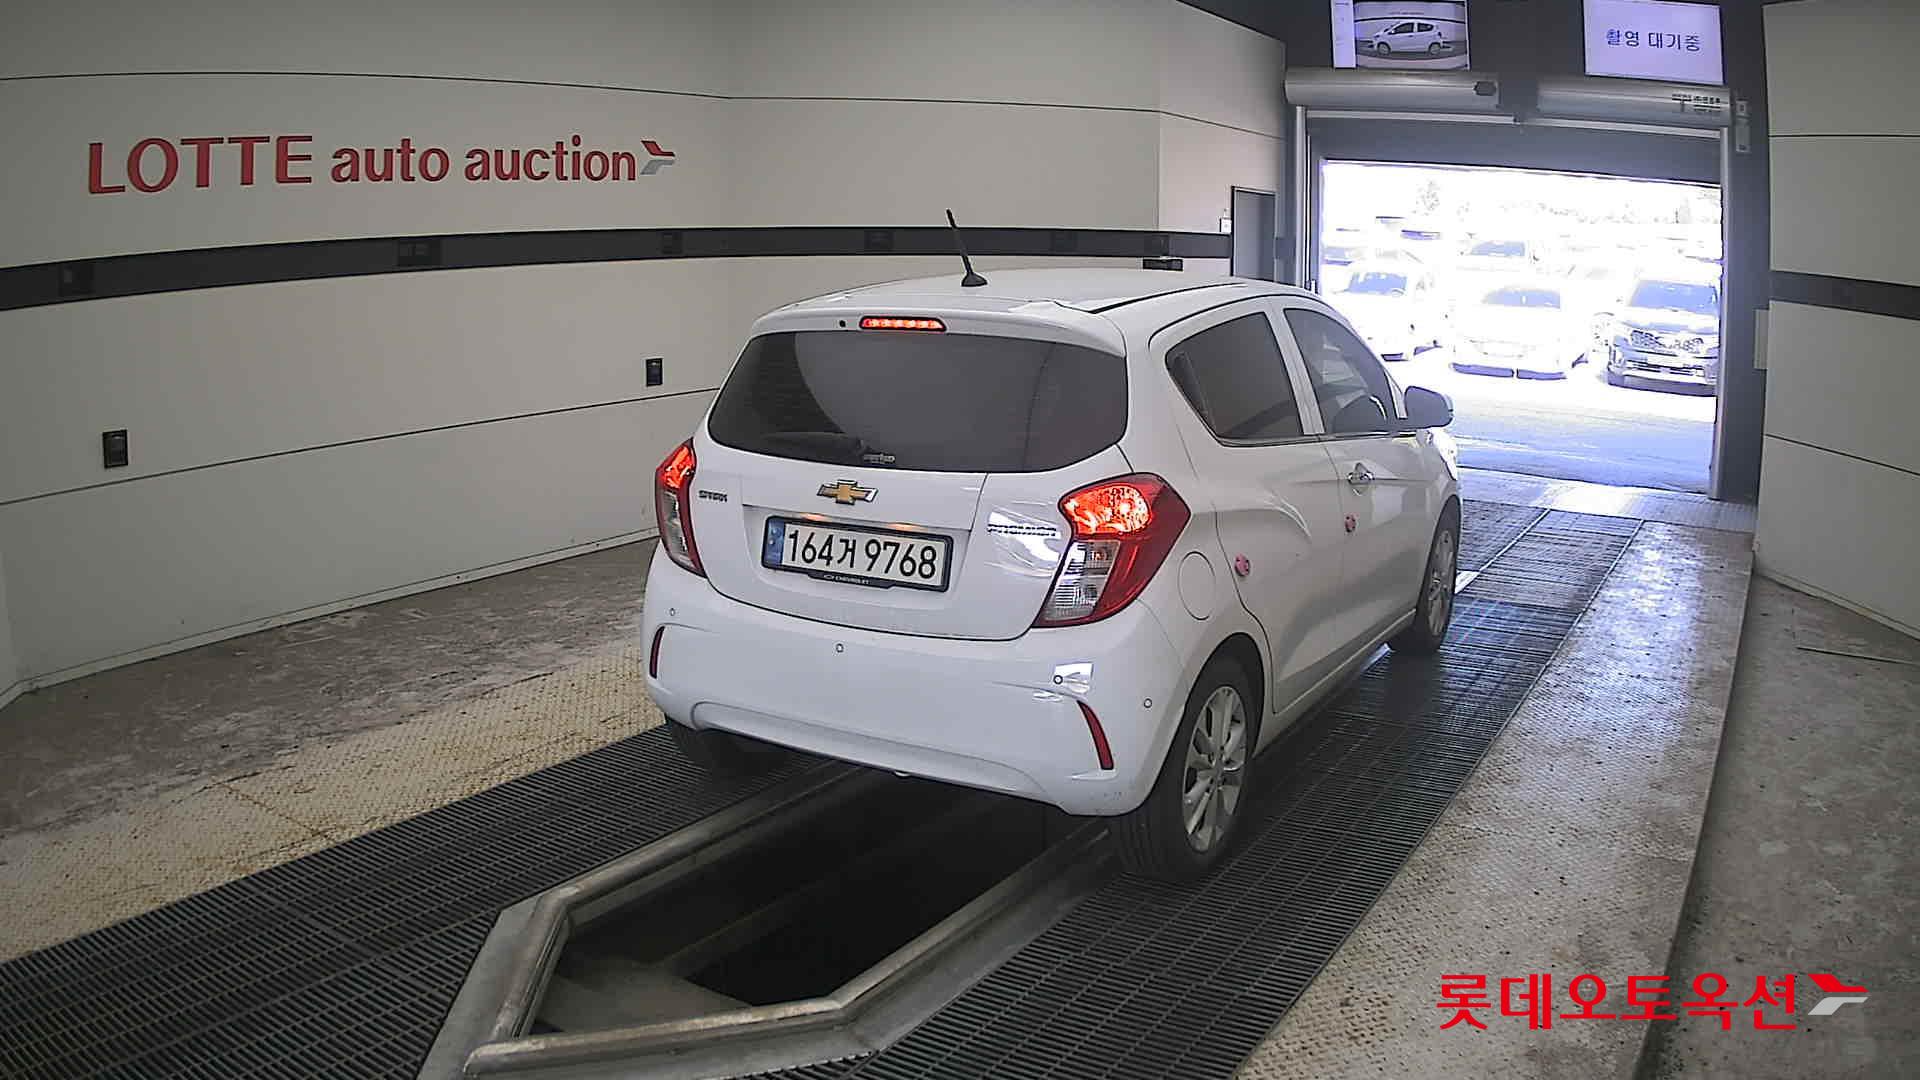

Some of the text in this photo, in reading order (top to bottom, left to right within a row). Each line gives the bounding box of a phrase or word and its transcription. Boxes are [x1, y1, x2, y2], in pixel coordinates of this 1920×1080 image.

[1647, 32, 1701, 53] 대기중
[88, 134, 637, 194] LOTTE auto auction
[788, 529, 937, 580] 164거 9768
